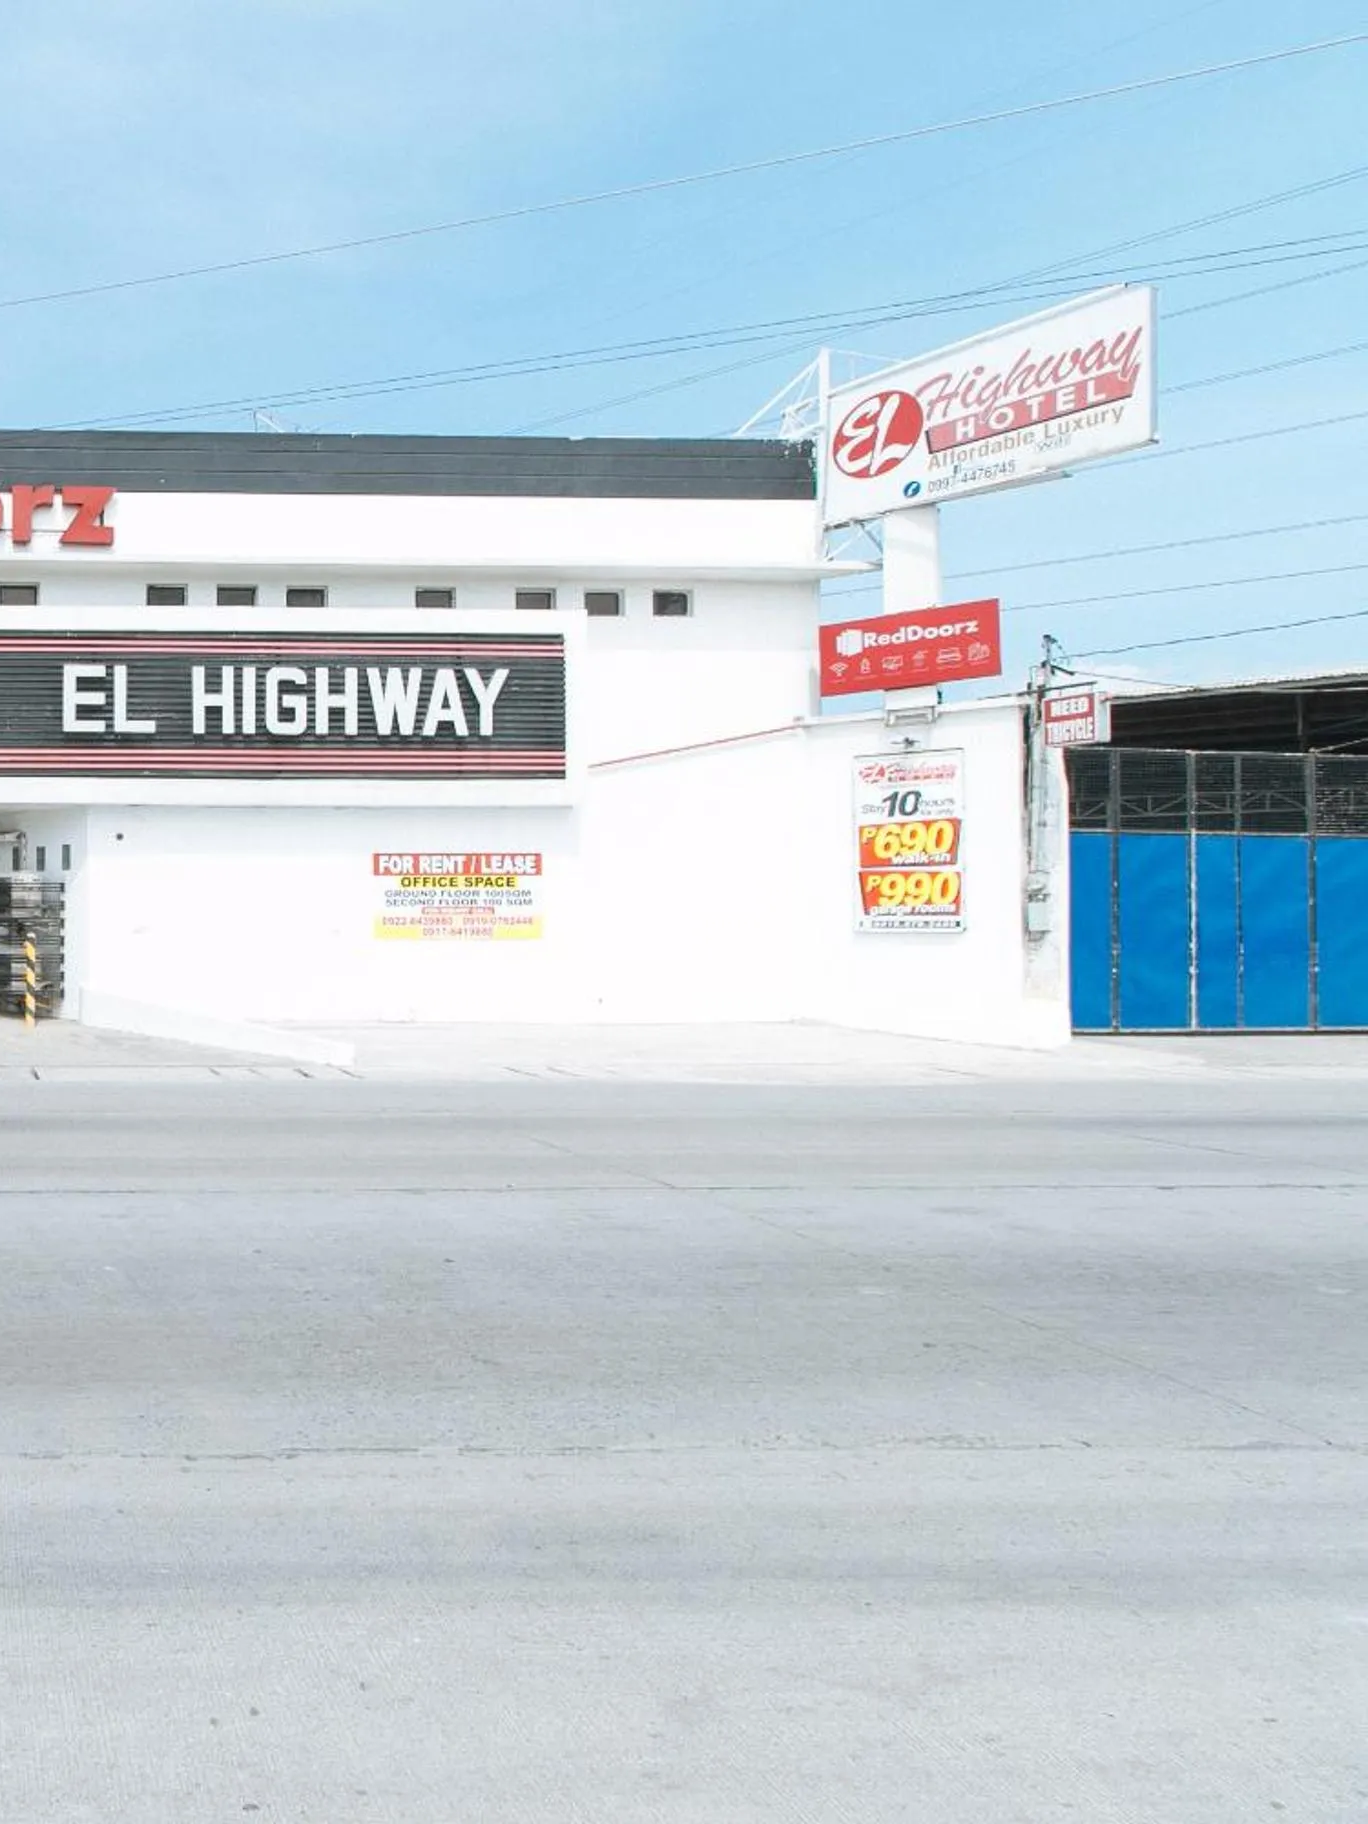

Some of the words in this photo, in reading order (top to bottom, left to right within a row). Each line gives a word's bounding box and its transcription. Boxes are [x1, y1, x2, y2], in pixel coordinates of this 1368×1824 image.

[916, 326, 1142, 418] Highway
[954, 379, 1107, 442] HOTEL
[836, 393, 914, 475] EL
[927, 428, 1037, 471] Affordable
[1044, 405, 1125, 440] Luxury
[863, 618, 979, 650] RedDoorz
[62, 663, 157, 733] EL
[191, 664, 510, 737] HIGHWAY
[882, 790, 922, 818] 10
[378, 855, 415, 874] FOR
[419, 855, 466, 874] RENT
[469, 855, 477, 873] /
[481, 855, 537, 874] LEASE
[384, 889, 438, 898] GROUND
[440, 889, 481, 898] FLOOR
[400, 876, 459, 888] OFFICE
[463, 876, 516, 888] SPACE
[385, 898, 435, 907] SECOND
[438, 898, 480, 907] FLOOR
